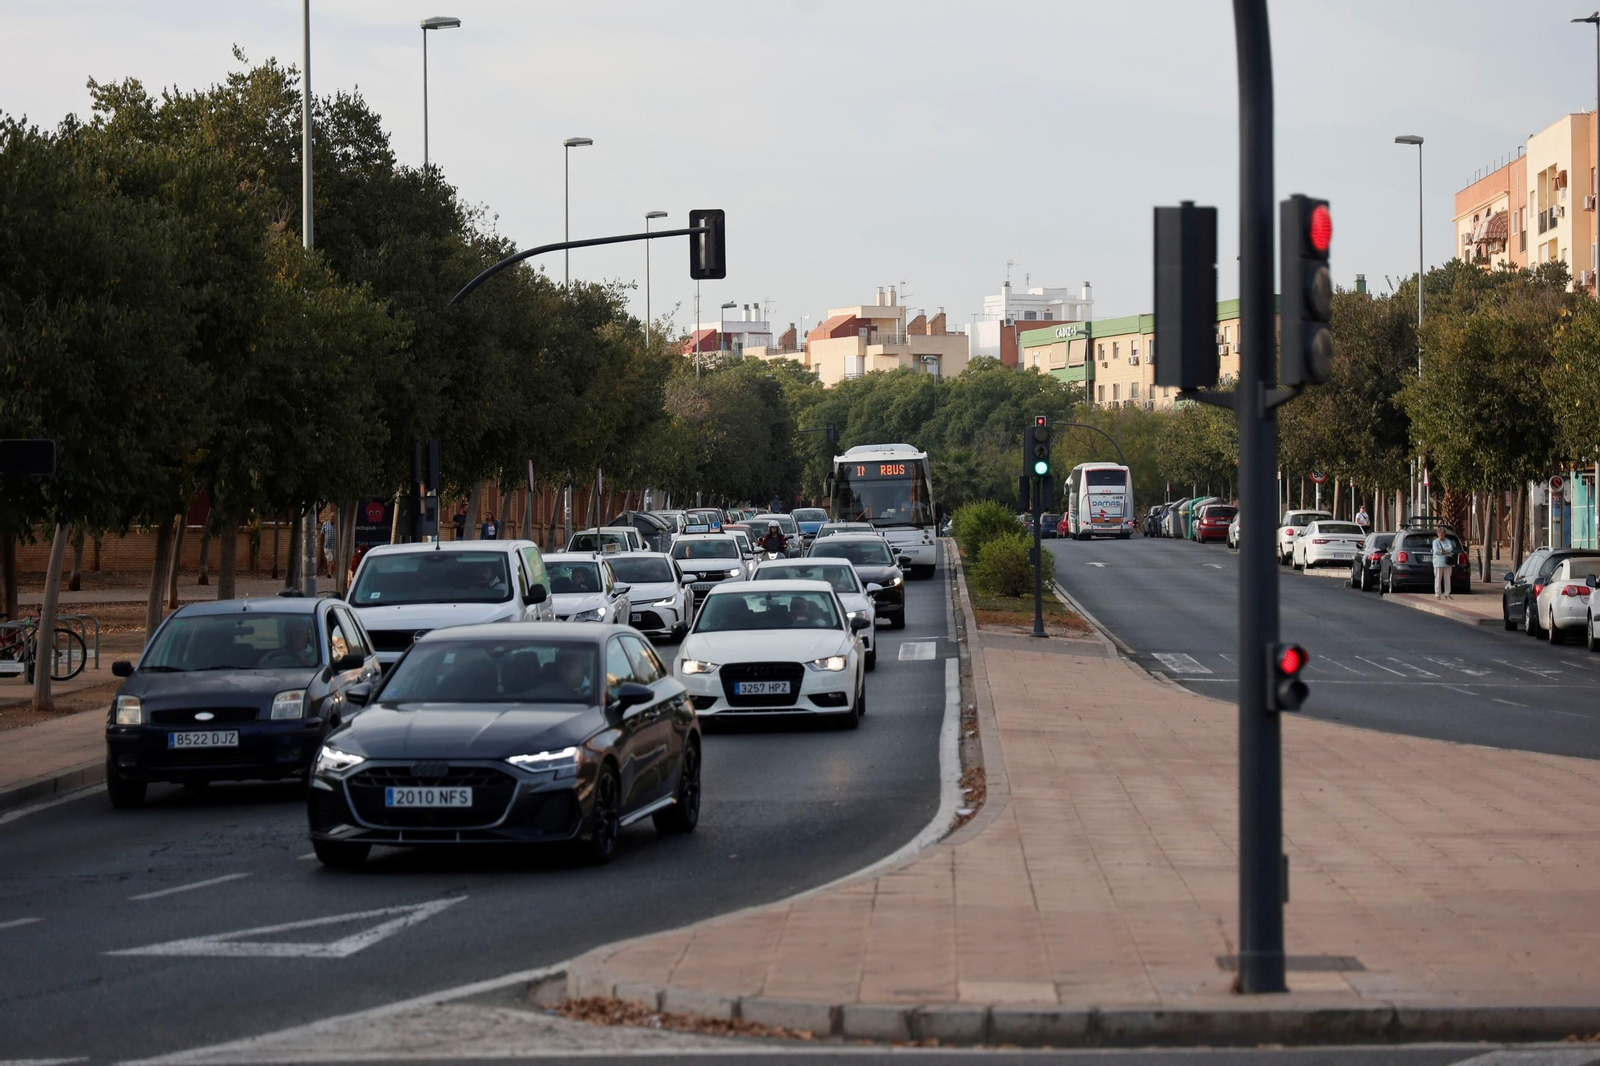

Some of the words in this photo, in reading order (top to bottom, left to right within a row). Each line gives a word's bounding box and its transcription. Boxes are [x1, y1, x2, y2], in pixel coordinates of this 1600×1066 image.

[741, 683, 766, 694] 3257
[768, 682, 788, 693] HPZ
[176, 733, 208, 746] 8522
[211, 732, 236, 745] DJZ
[396, 790, 435, 805] 2010
[438, 790, 468, 805] NFS
